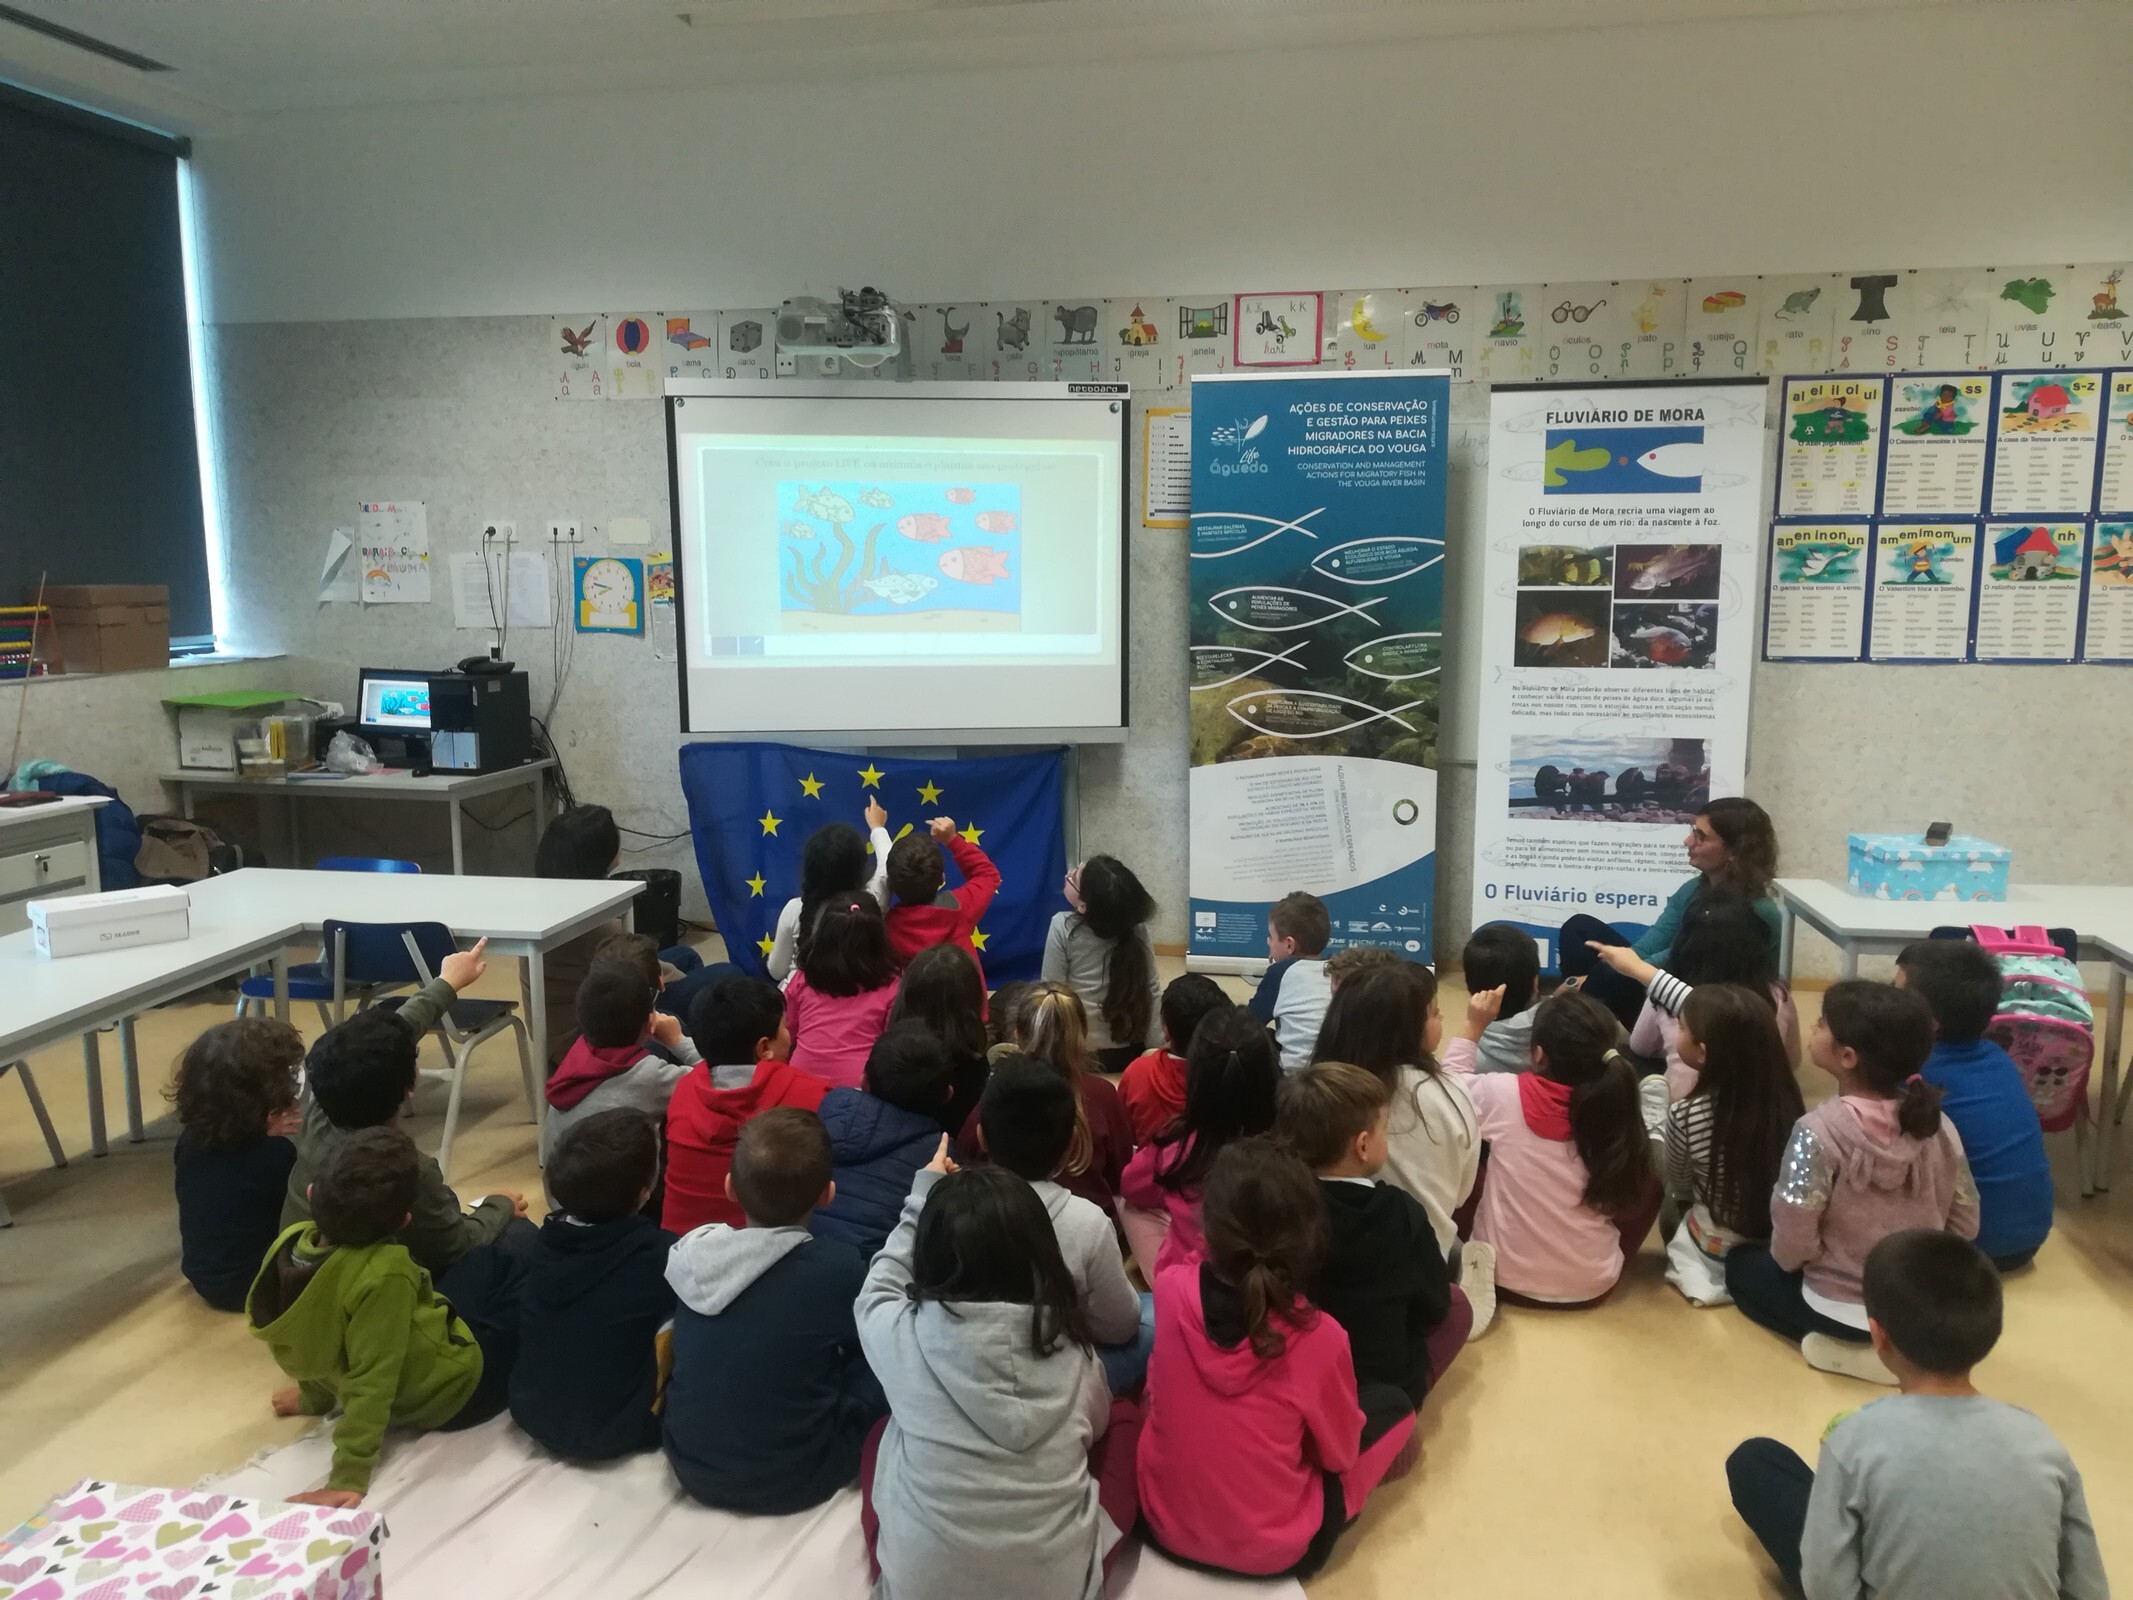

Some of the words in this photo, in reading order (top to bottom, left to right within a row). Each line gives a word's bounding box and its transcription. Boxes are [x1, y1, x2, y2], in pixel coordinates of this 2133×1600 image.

[2015, 323, 2038, 332] uvas
[2091, 320, 2122, 330] veado
[1494, 339, 1518, 347] navio
[1637, 333, 1657, 343] pato
[1886, 336, 1898, 351] S
[1964, 334, 1976, 349] T
[2042, 332, 2055, 347] U
[1589, 344, 1602, 359] O
[1663, 343, 1675, 357] P
[1733, 340, 1747, 355] Q
[1385, 351, 1393, 365] L
[1449, 350, 1463, 364] M
[1886, 355, 1896, 366] s
[2042, 351, 2052, 362] u
[1091, 361, 1099, 373] H
[1663, 357, 1673, 371] p
[1734, 356, 1744, 371] q
[592, 370, 600, 382] A
[1069, 385, 1118, 393] netboard
[1793, 391, 1805, 402] al
[1810, 385, 1823, 396] el
[1846, 384, 1859, 395] ol
[1864, 389, 1877, 400] ul
[1965, 385, 1982, 394] ss
[1289, 401, 1326, 415] AÇÕES
[1329, 403, 1343, 412] DE
[1346, 399, 1428, 412] CONSERVAÇÃO
[1307, 418, 1314, 427] E
[1316, 415, 1358, 427] GESTÃO
[1361, 416, 1387, 426] PARA
[1390, 415, 1427, 425] PEIXES
[1546, 408, 1629, 424] FLUVIÁRIO
[1634, 410, 1654, 422] DE
[1659, 408, 1705, 422] MORA
[1305, 430, 1374, 441] MIGRADORES
[1377, 430, 1392, 440] NA
[1395, 429, 1427, 439] BACIA
[1288, 443, 1366, 455] HIDROGRÁFICA
[1368, 444, 1384, 454] DO
[1387, 443, 1427, 453] VOUGA
[1239, 446, 1260, 465] Life
[1297, 462, 1353, 470] CONSERVATION
[1355, 461, 1371, 470] AND
[1373, 460, 1426, 469] MANAGEMENT
[1306, 471, 1338, 479] ACTIONS
[1340, 471, 1355, 479] FOR
[1357, 470, 1398, 478] MIGRATORY
[1418, 469, 1426, 477] IN
[1382, 479, 1402, 487] RIVER
[1529, 507, 1535, 516] O
[1538, 506, 1576, 516] Fluviário
[1579, 506, 1590, 515] de
[1592, 506, 1614, 515] Mora
[1617, 506, 1643, 515] recria
[1668, 506, 1701, 517] viagem
[1522, 519, 1546, 529] longo
[1549, 519, 1560, 527] do
[1589, 518, 1601, 527] de
[1638, 518, 1649, 526] da
[1652, 518, 1692, 527] nascente
[1703, 517, 1721, 527] foz.
[1777, 538, 1793, 546] an
[1795, 531, 1810, 540] en
[1847, 537, 1864, 545] un
[1899, 531, 1918, 539] em
[1953, 536, 1972, 544] um
[2058, 530, 2076, 541] nh
[1484, 883, 1497, 899] O
[1505, 885, 1587, 903] Fluviário
[1595, 892, 1658, 909] espera
